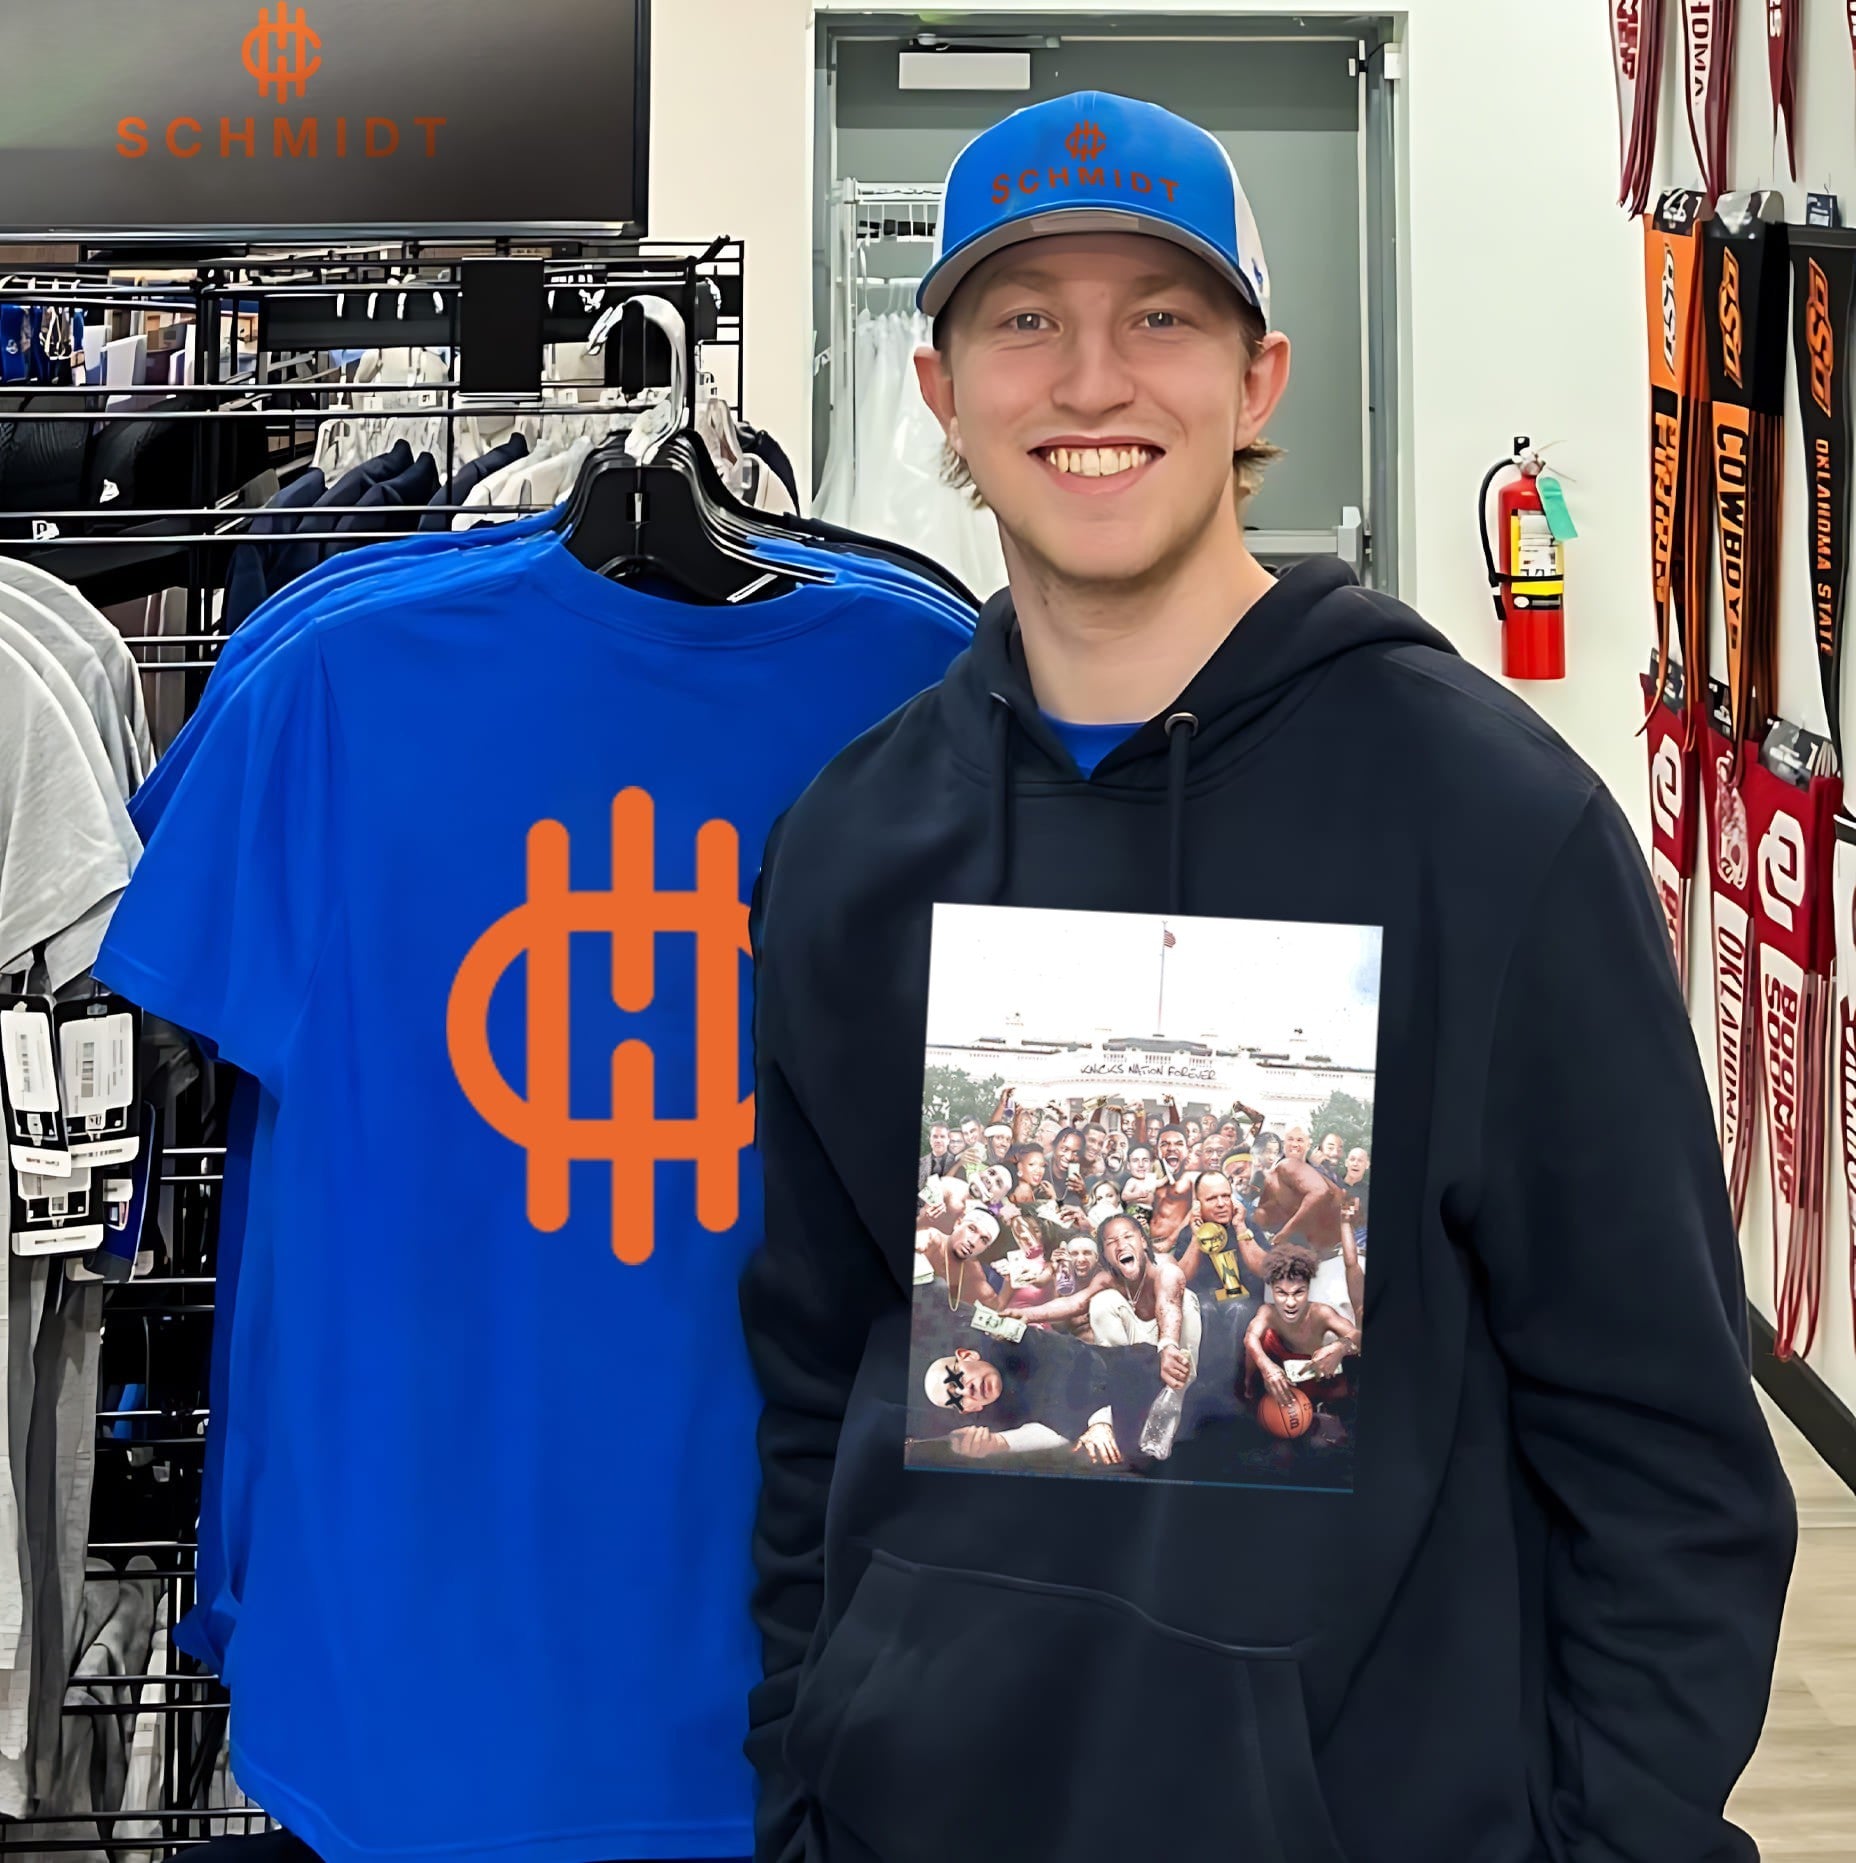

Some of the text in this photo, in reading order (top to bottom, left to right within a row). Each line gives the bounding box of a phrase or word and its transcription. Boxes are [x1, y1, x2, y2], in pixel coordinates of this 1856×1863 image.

[115, 116, 447, 159] SCHMIDT
[991, 166, 1179, 205] SCHMIDT
[1815, 438, 1833, 656] OKLAHOMA STATE
[1718, 926, 1746, 1144] OKLAHOMA
[1080, 1062, 1217, 1081] KNICKS NATION FOREVER
